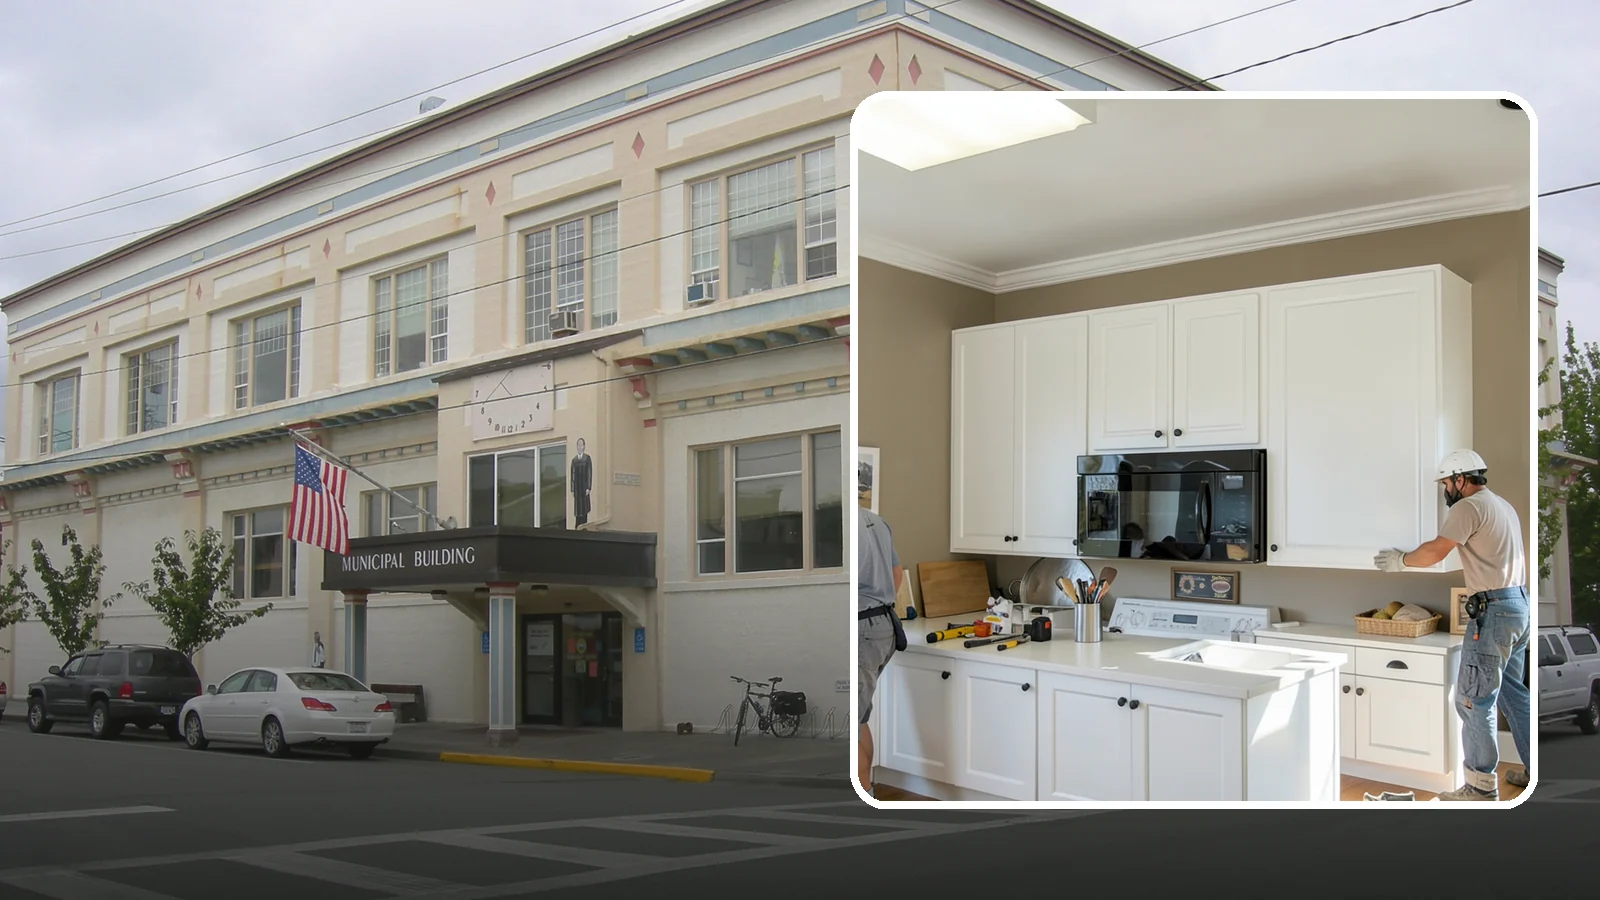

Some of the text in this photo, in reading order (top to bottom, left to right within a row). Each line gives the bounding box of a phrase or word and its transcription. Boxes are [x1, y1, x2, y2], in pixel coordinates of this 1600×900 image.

[546, 362, 552, 370] 6
[536, 402, 540, 410] 4
[529, 414, 533, 422] 3
[342, 546, 475, 572] MUNICIPAL BUILDING
